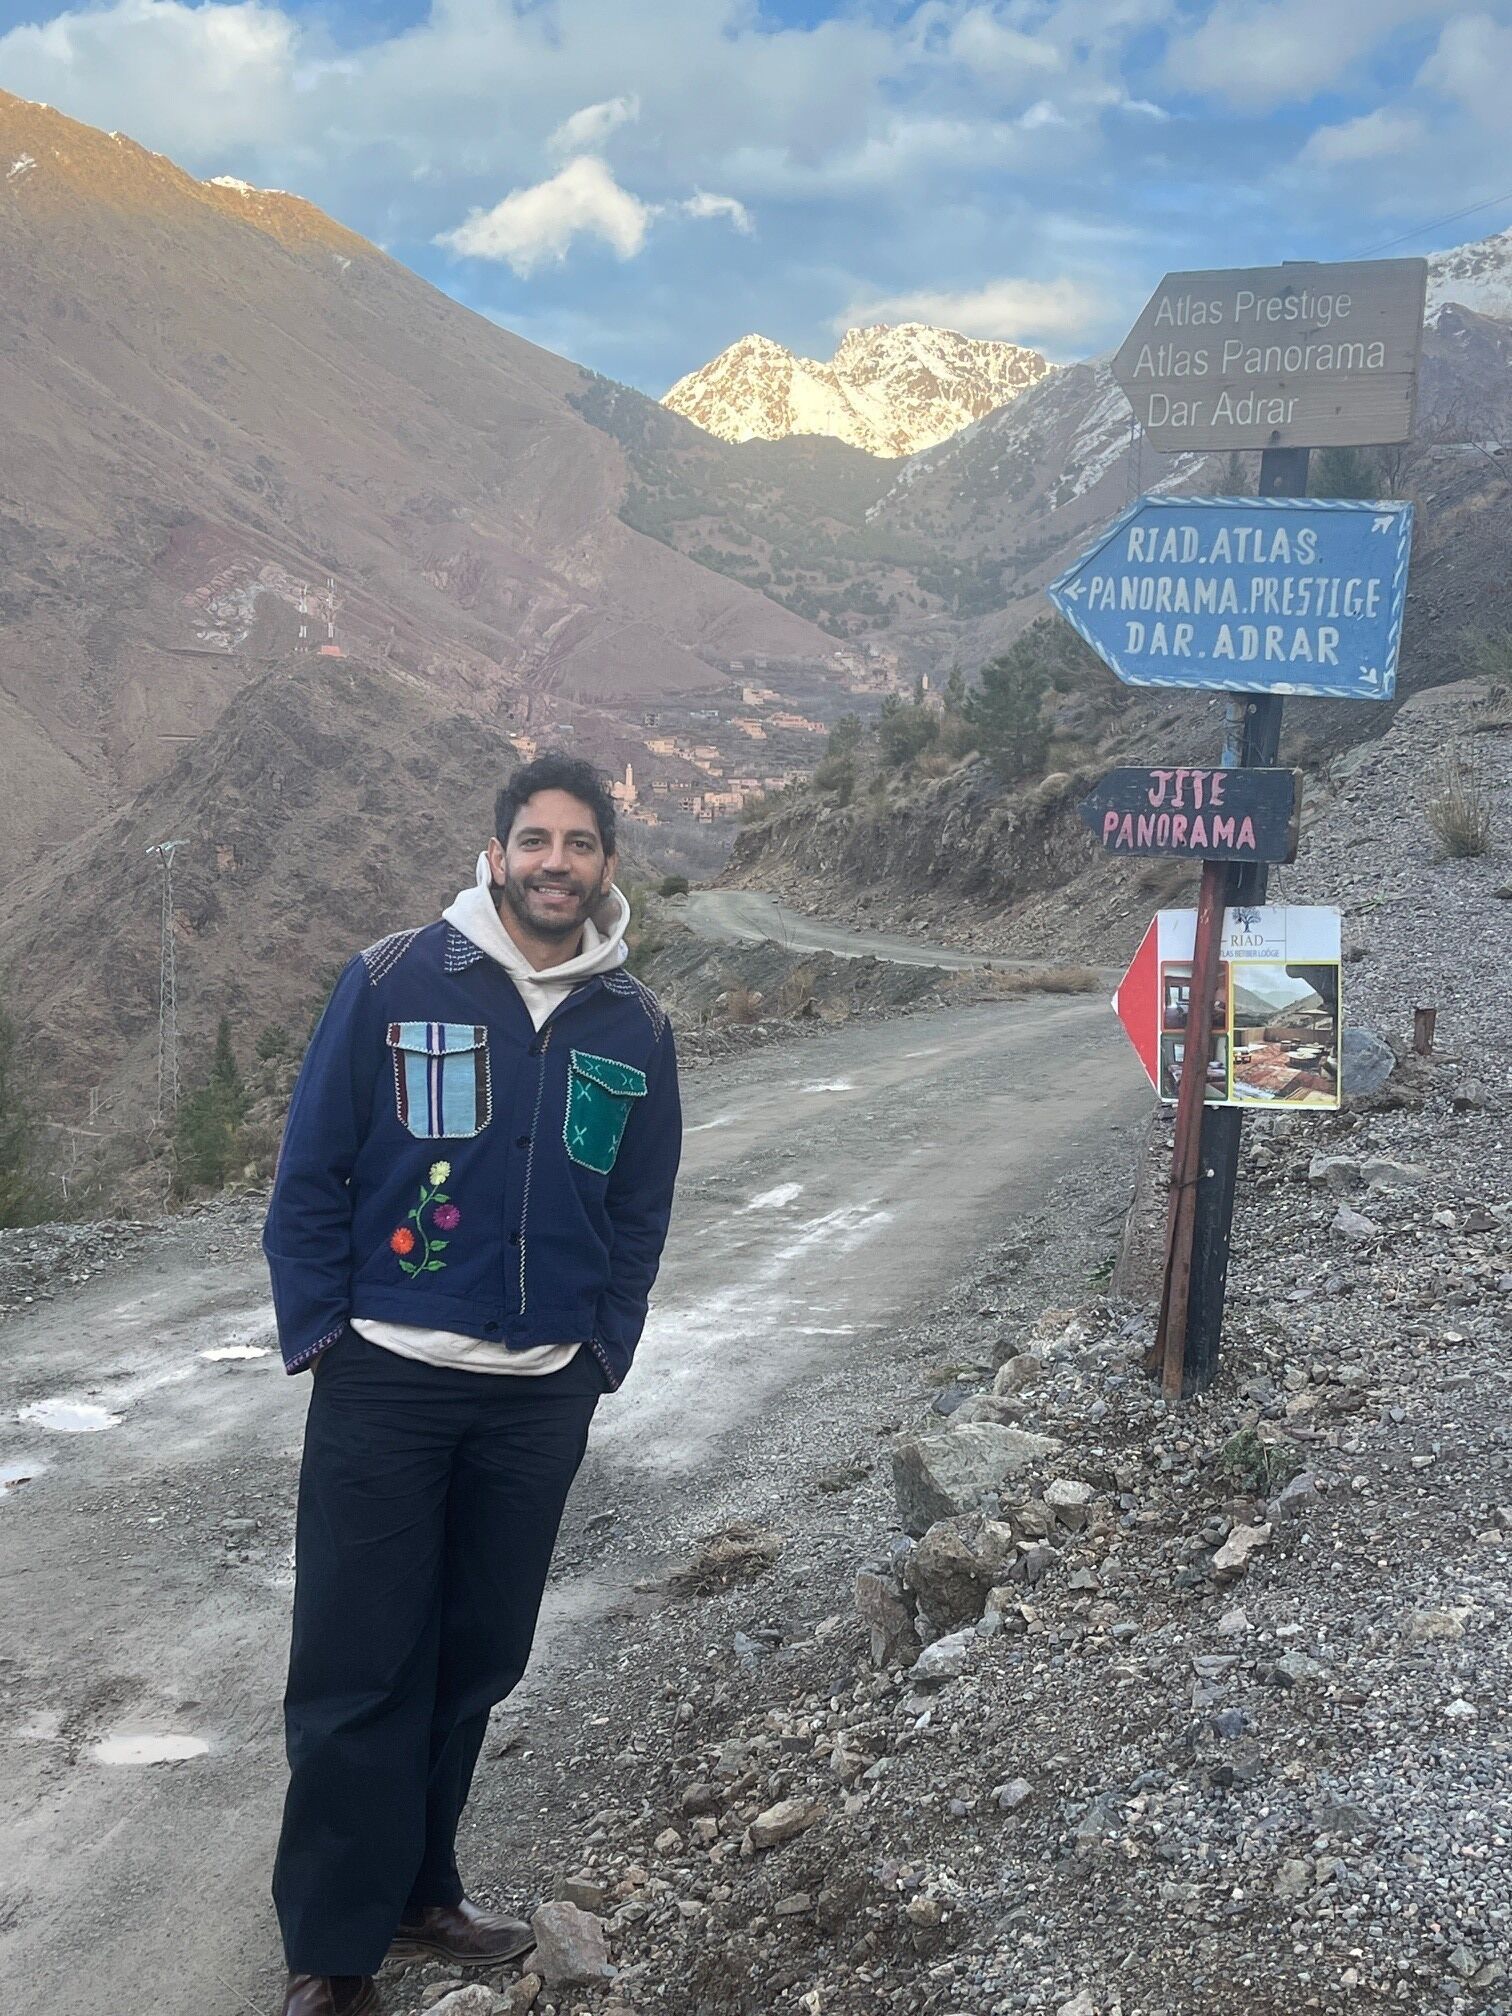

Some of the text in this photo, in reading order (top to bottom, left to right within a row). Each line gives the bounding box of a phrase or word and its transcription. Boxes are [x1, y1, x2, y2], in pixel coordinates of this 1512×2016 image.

[1154, 290, 1351, 327] Atlas Prestige
[1132, 340, 1385, 378] Atlas Panorama
[1148, 391, 1299, 427] Dar Adrar
[1148, 769, 1228, 809] JITE
[1103, 811, 1256, 850] PANORAMA
[1230, 934, 1264, 947] RIAD
